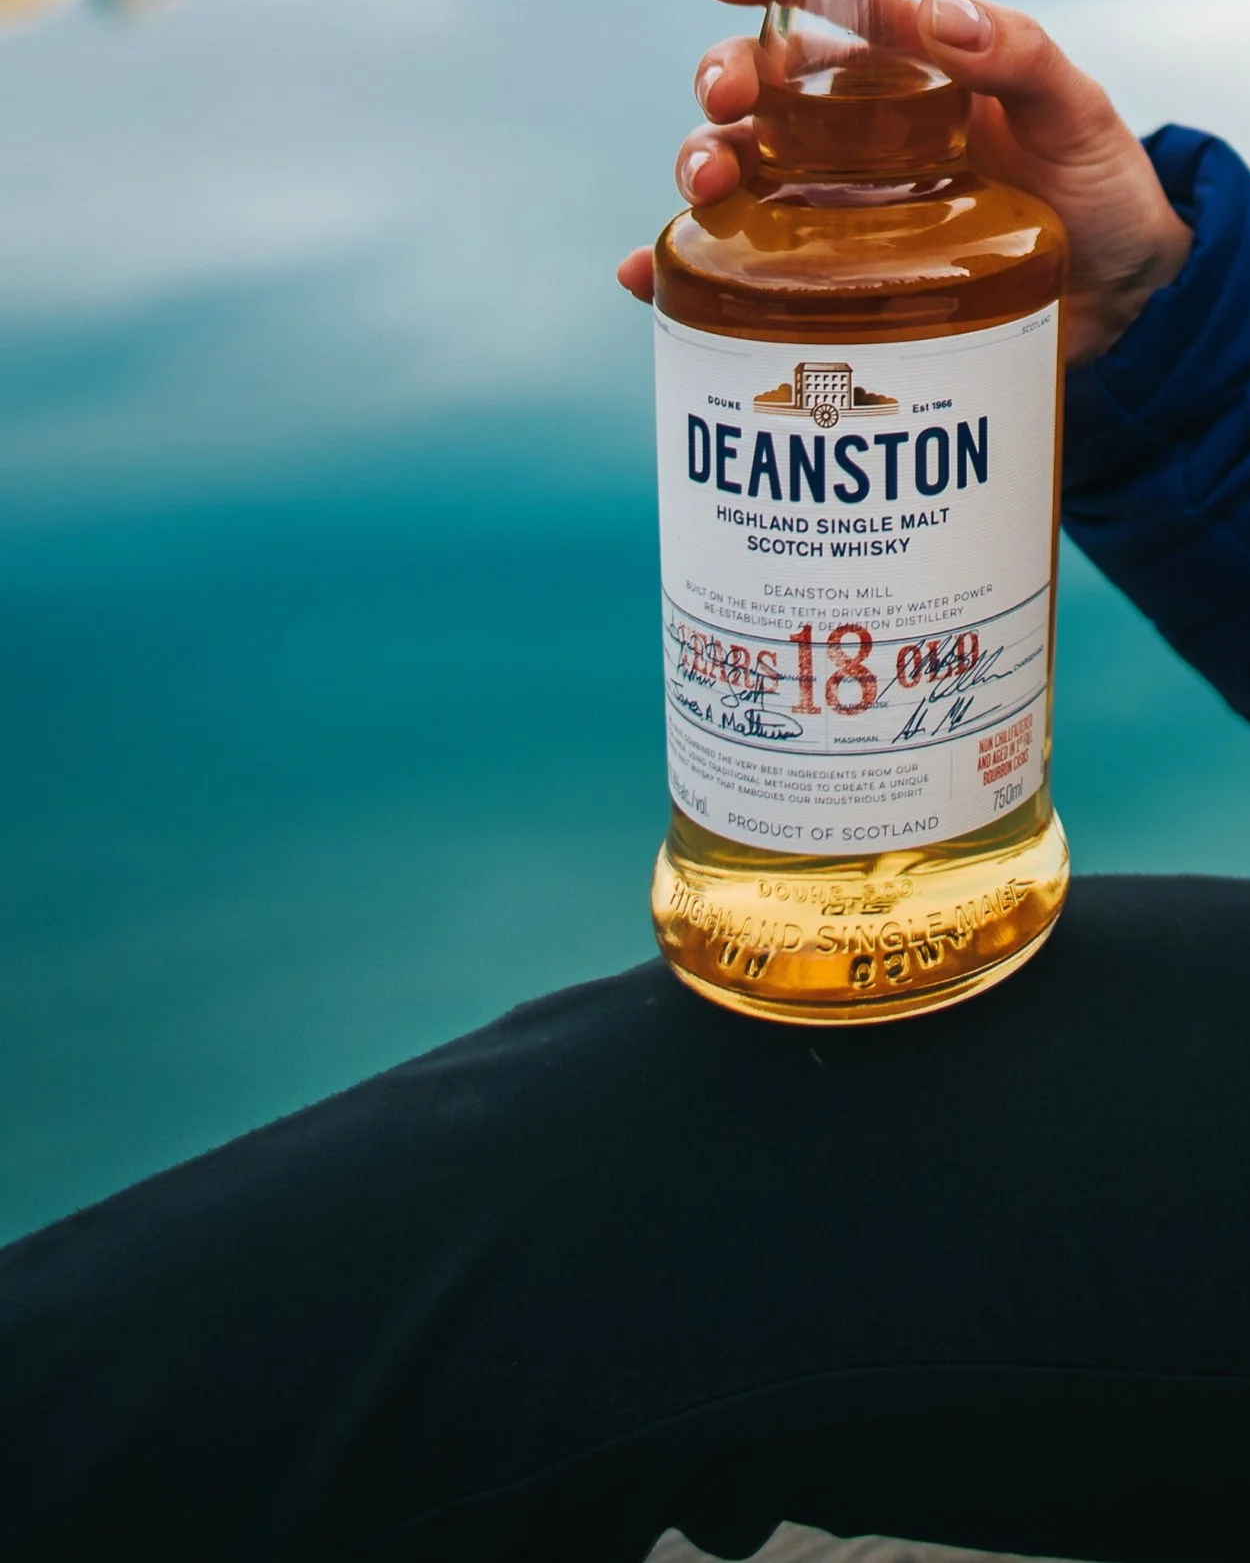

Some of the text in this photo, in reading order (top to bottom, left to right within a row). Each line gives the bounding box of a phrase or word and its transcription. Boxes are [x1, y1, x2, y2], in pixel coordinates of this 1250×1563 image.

[707, 395, 742, 411] DOUNE
[912, 403, 929, 413] Est
[687, 414, 989, 504] DEANSTON
[716, 505, 951, 535] HIGHLAND SINGLE MALT
[747, 536, 911, 558] SCOTCH WHISKY
[686, 580, 993, 618] BUILT ON THE RIVER TEITH DRIVEN BY WATER POWER
[764, 584, 894, 599] DEANSTON MILL
[704, 602, 793, 630] RE-ESTABLISHED
[895, 606, 965, 628] DISTILLERY
[789, 623, 878, 716] 18
[896, 630, 979, 689] OLD
[834, 735, 879, 744] MASHMAN
[708, 760, 761, 785] TRADITIONAL
[764, 779, 813, 791] METHODS
[817, 782, 830, 792] TO
[834, 782, 878, 793] CREATE
[879, 780, 886, 790] A
[889, 773, 930, 789] UNIQUE
[718, 753, 732, 765] THE
[735, 759, 758, 771] VERY
[760, 764, 784, 776] BEST
[787, 769, 858, 780] INGREDIENTS
[861, 768, 892, 778] FROM
[896, 763, 919, 775] OUR
[977, 753, 992, 772] AND
[716, 778, 735, 790] THAT
[738, 785, 785, 802] EMBODIES
[789, 794, 811, 804] OUR
[814, 794, 887, 805] INDUSTRIOUS
[890, 788, 923, 801] SPIRIT
[993, 776, 1024, 811] 750ml
[728, 812, 940, 841] PRODUCT OF SCOTLAND
[670, 877, 804, 954] HIGHLAND
[816, 911, 943, 955] SINGLE
